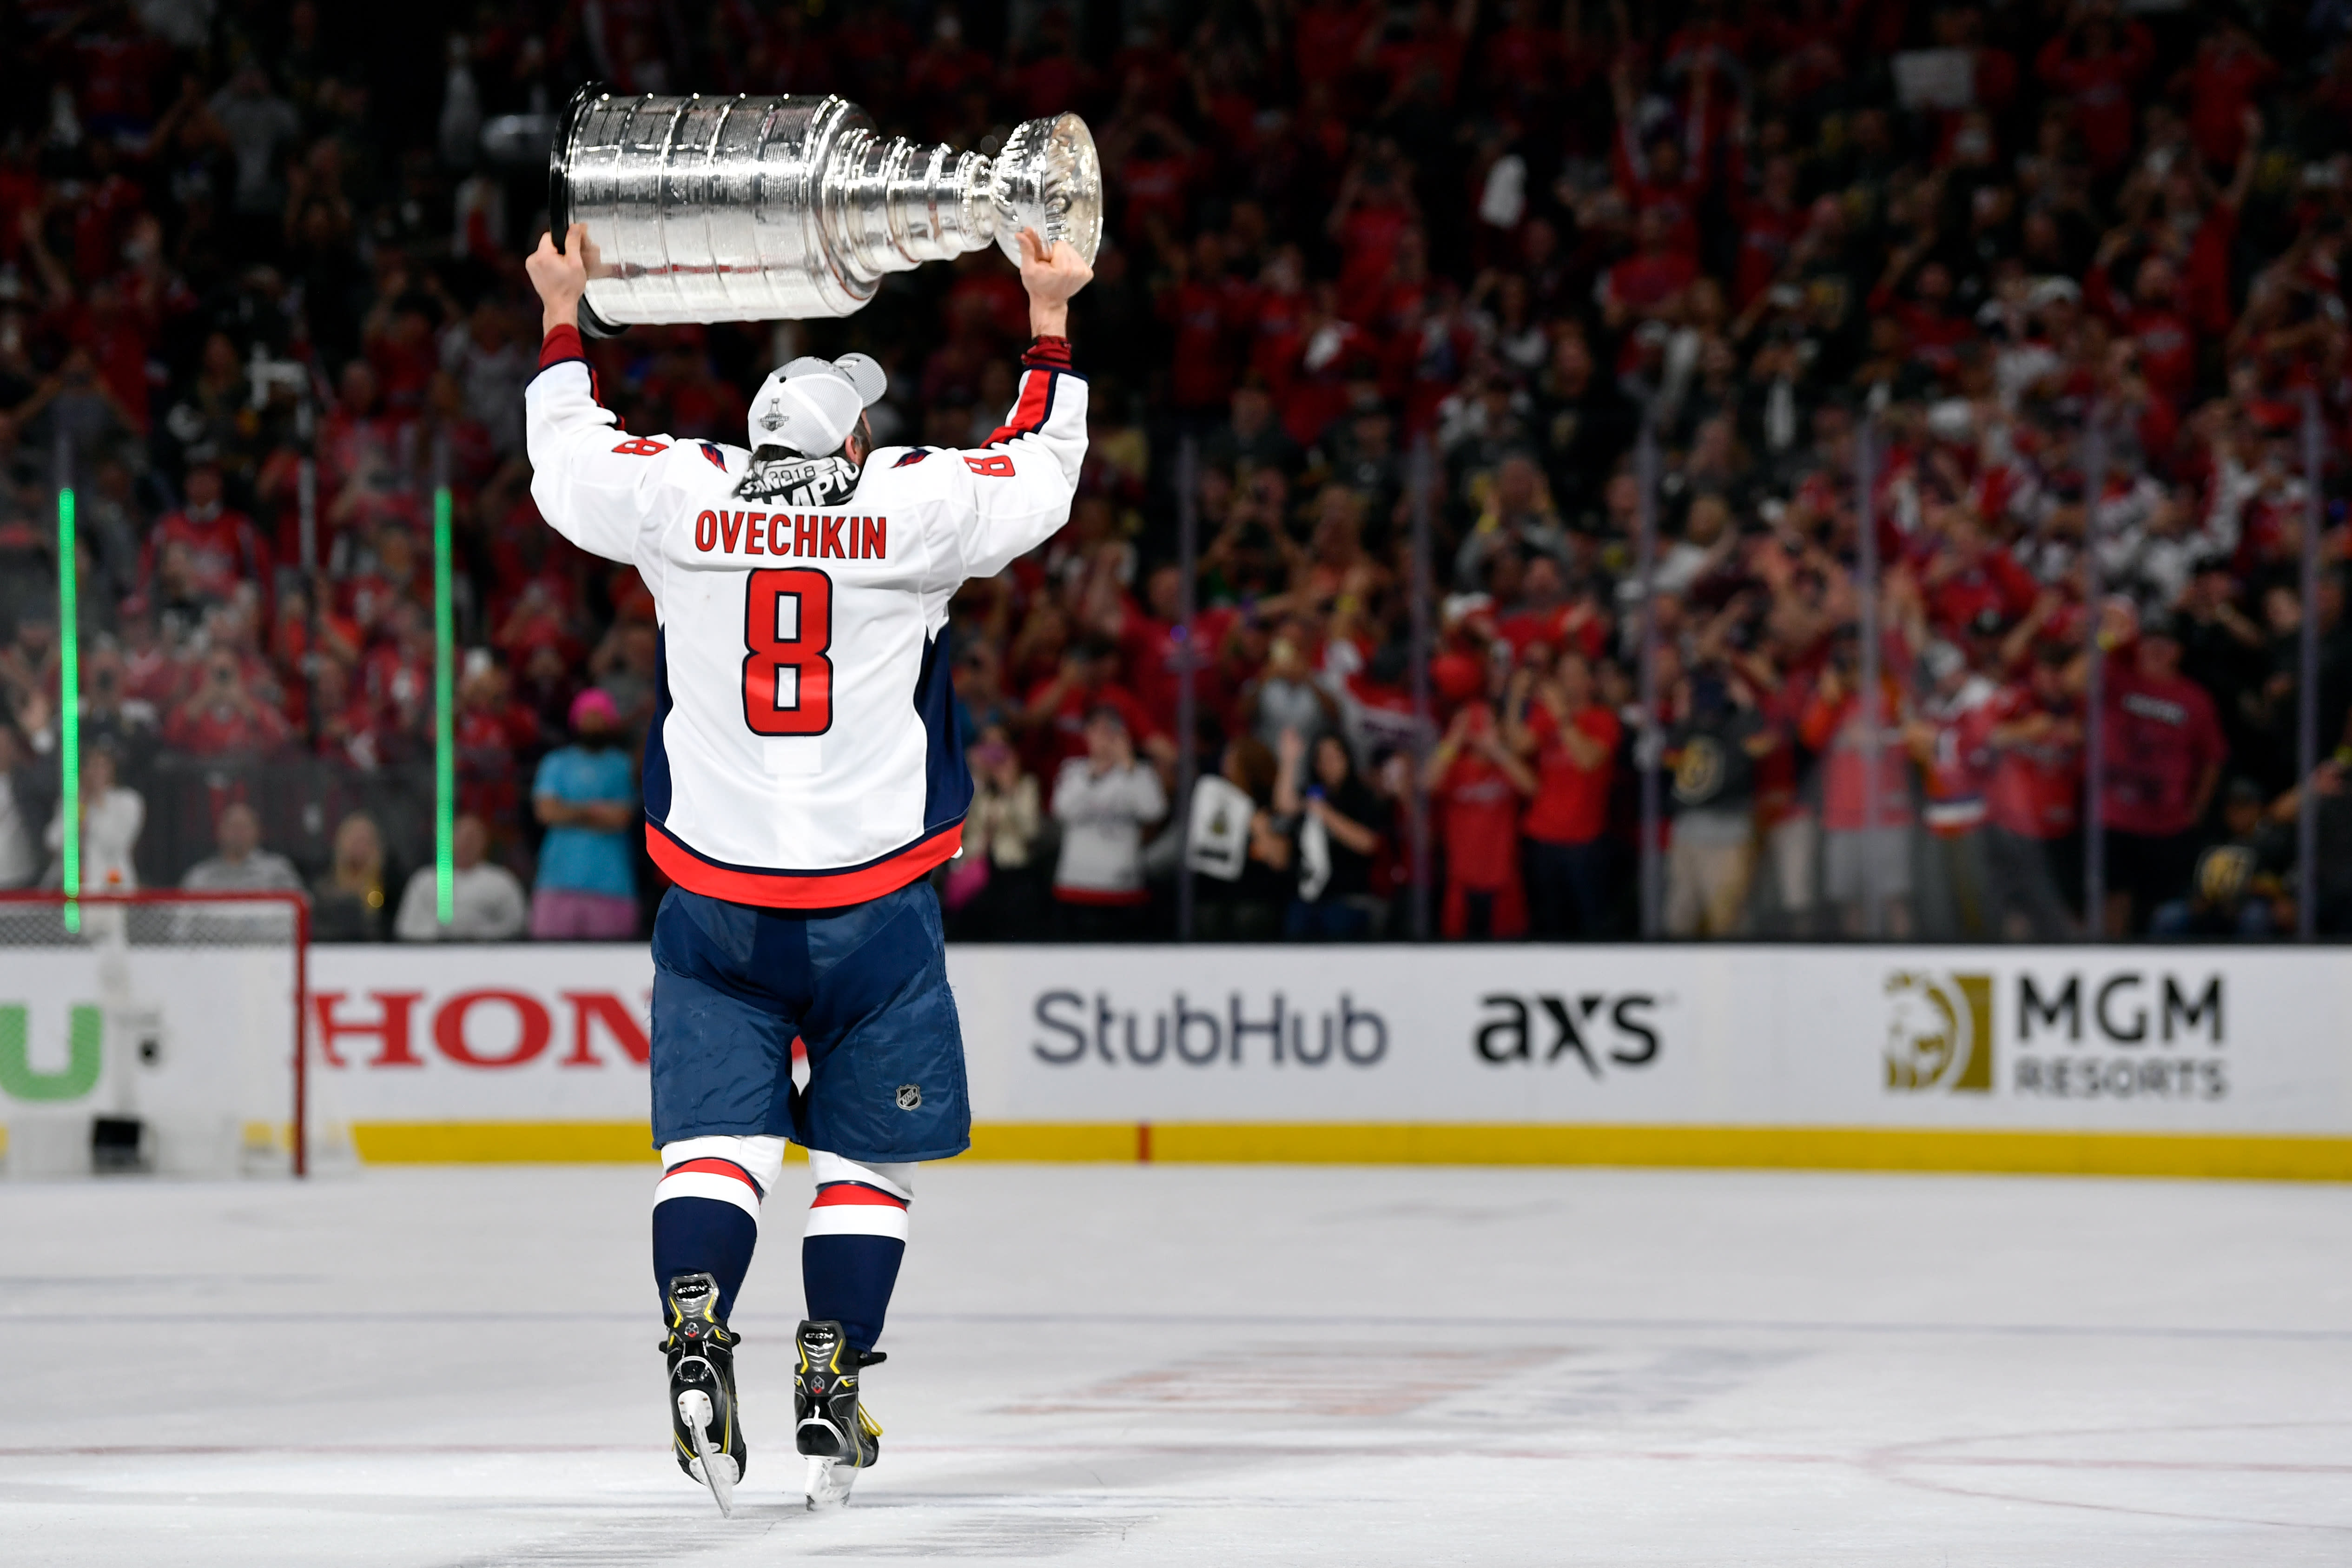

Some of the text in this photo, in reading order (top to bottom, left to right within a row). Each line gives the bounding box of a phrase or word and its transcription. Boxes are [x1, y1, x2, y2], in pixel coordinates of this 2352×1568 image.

[611, 437, 669, 456] 8
[963, 454, 1016, 477] 8
[768, 466, 816, 481] 2018
[695, 510, 886, 559] OVECHKIN
[741, 567, 833, 736] 8
[314, 989, 650, 1069] HON
[1032, 989, 1390, 1069] StubHub
[2018, 973, 2224, 1046] MGM
[902, 1090, 916, 1105] NHL
[2015, 1059, 2226, 1099] RESORTS
